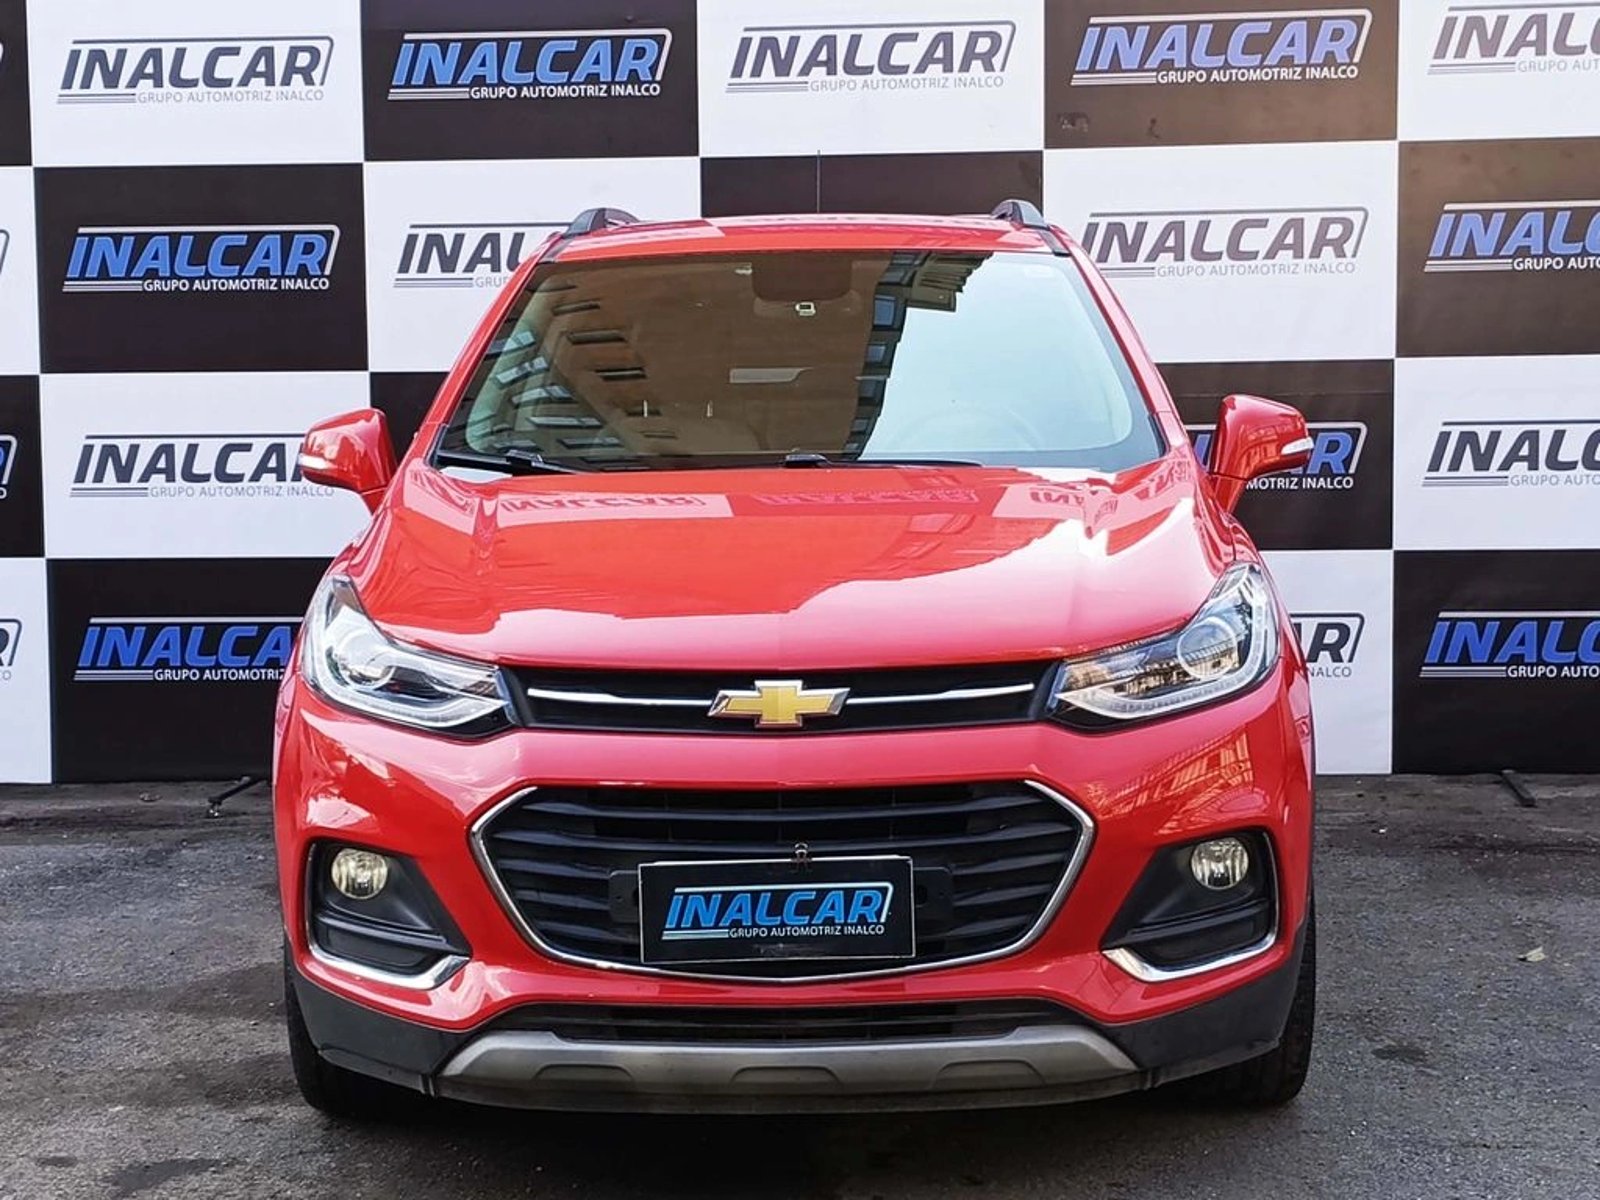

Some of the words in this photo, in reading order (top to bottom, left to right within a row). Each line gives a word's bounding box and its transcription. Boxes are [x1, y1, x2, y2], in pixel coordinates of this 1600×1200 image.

[1075, 19, 1358, 71] INALCAR
[1432, 13, 1600, 59] INAL
[391, 39, 659, 85] INALCAR
[730, 30, 1003, 79] INALCAR
[60, 46, 321, 89] INALCAR
[1157, 70, 1206, 84] GRUPO
[1210, 68, 1302, 83] AUTOMOTRIZ
[1305, 65, 1359, 80] INALCO
[470, 86, 517, 99] GRUPO
[520, 85, 608, 98] AUTOMOTRIZ
[611, 83, 661, 97] INALCO
[810, 79, 857, 92] GRUPO
[860, 77, 949, 91] AUTOMOTRIZ
[953, 75, 1004, 89] INALCO
[137, 91, 183, 104] GRUPO
[187, 90, 272, 103] AUTOMOTRIZ
[275, 90, 324, 102] INALCO
[1081, 217, 1355, 263] INALCAR
[1428, 210, 1600, 257] INAL
[66, 234, 327, 278] INALCAR
[397, 232, 525, 274] INAL
[1157, 265, 1205, 278] GRUPO
[1209, 263, 1300, 277] AUTOMOTRIZ
[1303, 261, 1355, 275] INALCO
[1513, 257, 1564, 271] GRUPO
[143, 279, 190, 292] GRUPO
[192, 278, 278, 291] AUTOMOTRIZ
[281, 277, 330, 290] INALCO
[474, 276, 510, 289] GRU
[1427, 429, 1600, 472] INALC
[1246, 477, 1299, 490] MOTRIZ
[1302, 476, 1354, 490] INALCO
[1510, 475, 1559, 487] GRUPO
[150, 486, 195, 498] GRUPO
[199, 485, 284, 498] AUTOMOTRIZ
[287, 485, 335, 497] INALCO
[77, 625, 291, 667] INALCA
[1424, 620, 1600, 663] INALC
[154, 668, 200, 681] GRUPO
[1507, 665, 1557, 678] GRUPO
[666, 889, 882, 928] INALCAR
[729, 927, 768, 939] GRUPO
[770, 925, 842, 937] AUTOMOTRIZ
[844, 924, 885, 936] INALCO
